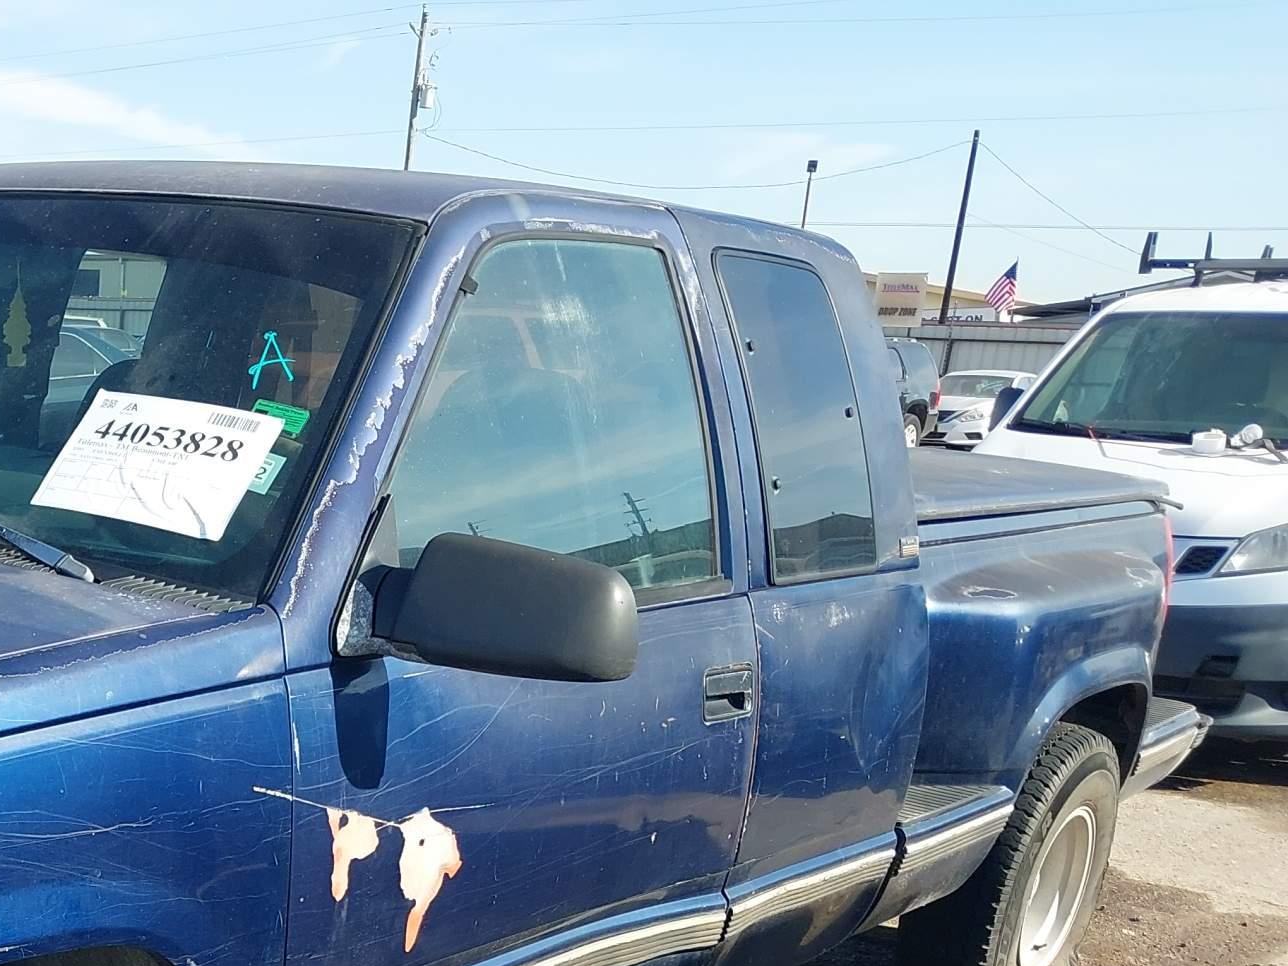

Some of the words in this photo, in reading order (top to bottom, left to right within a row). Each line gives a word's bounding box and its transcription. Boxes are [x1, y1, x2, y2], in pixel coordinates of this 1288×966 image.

[878, 307, 898, 316] DROP
[248, 331, 296, 390] A
[95, 418, 244, 463] 44053828
